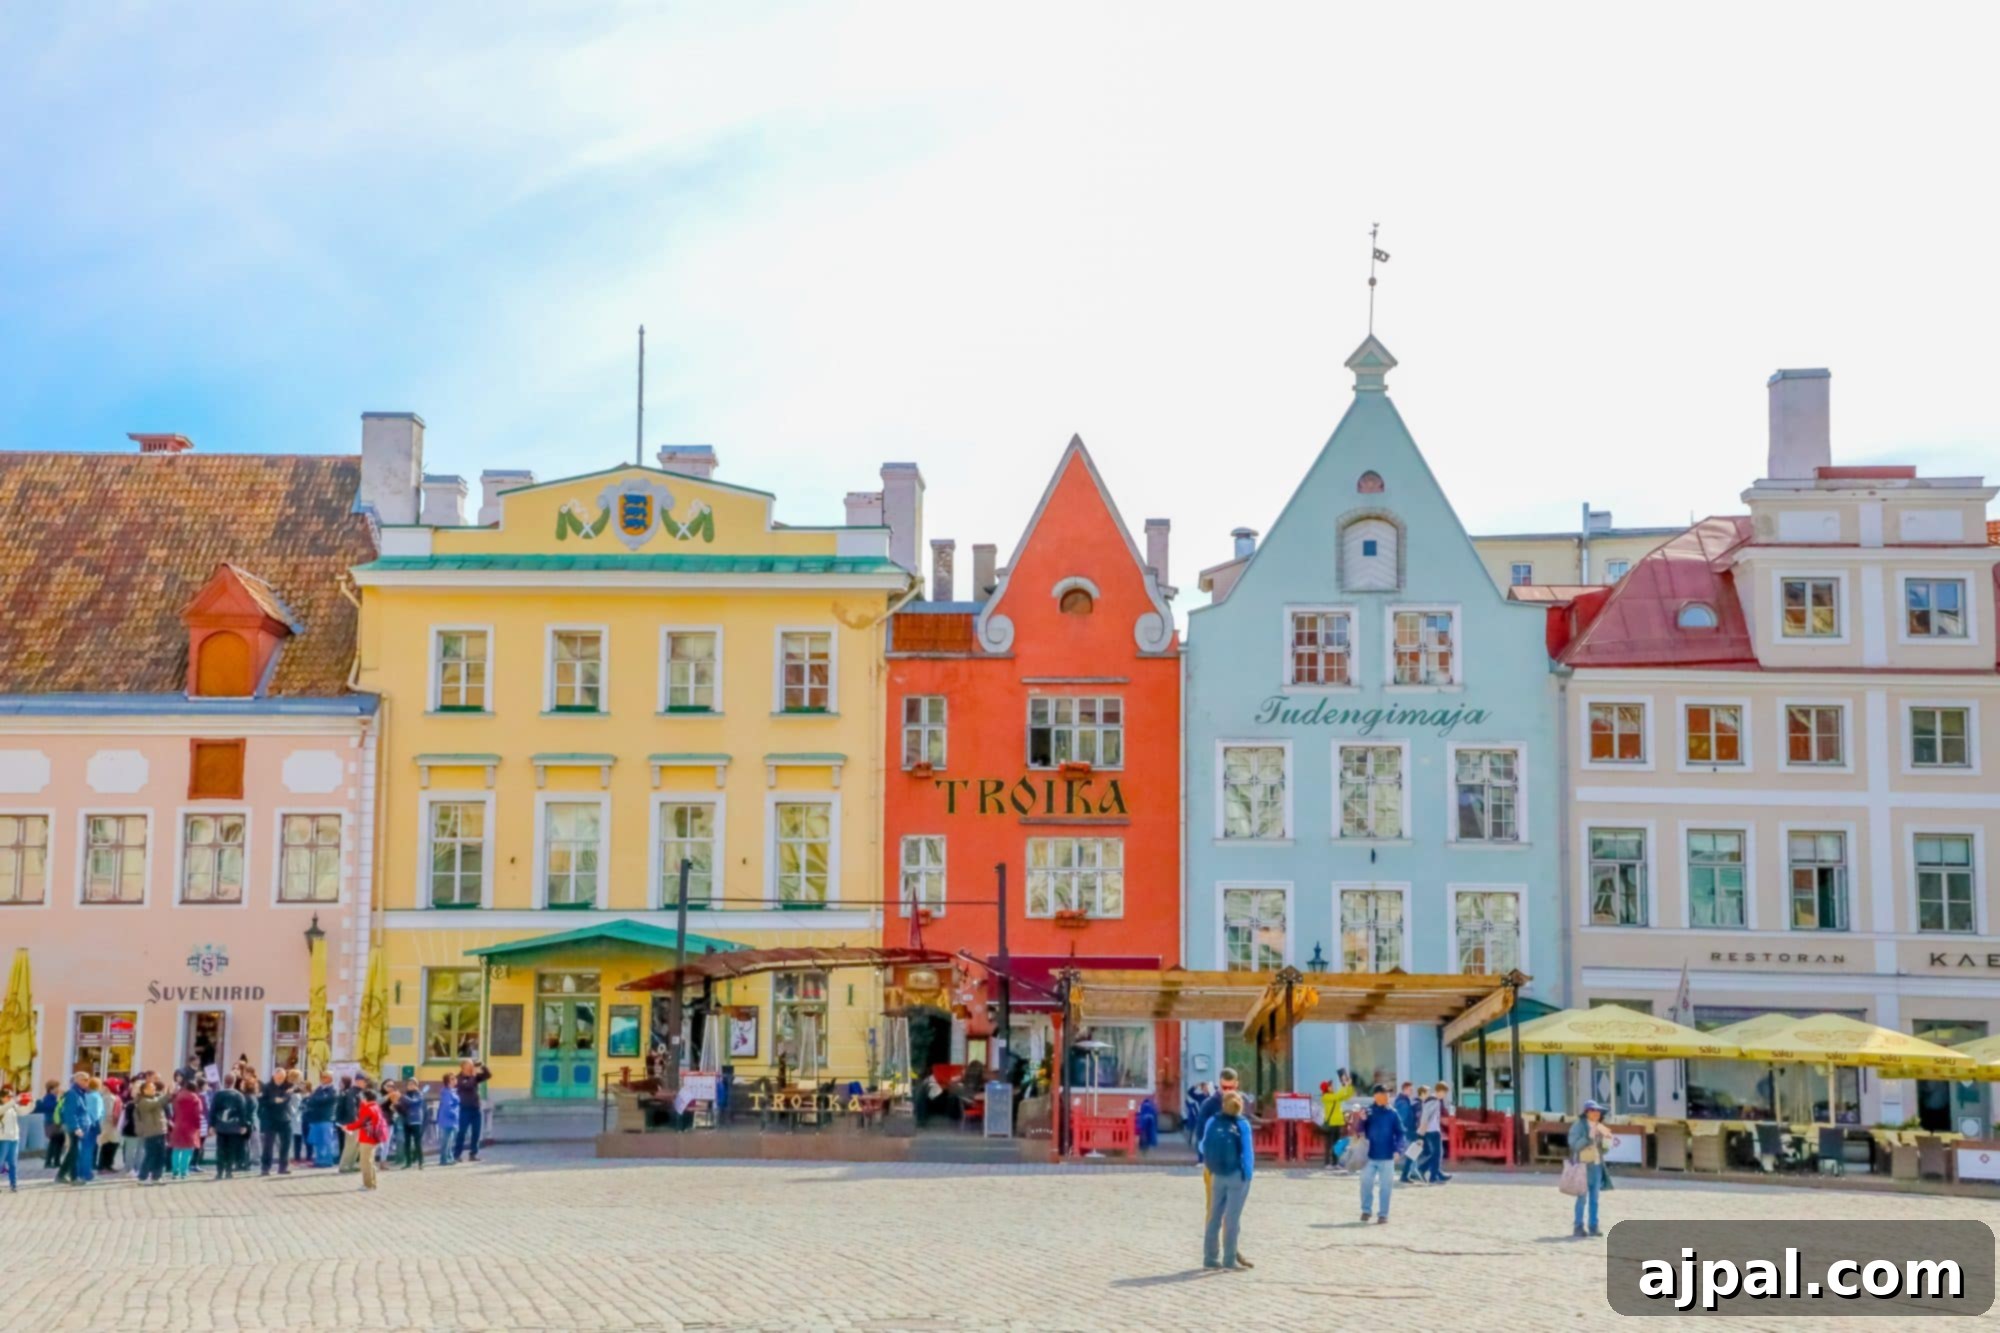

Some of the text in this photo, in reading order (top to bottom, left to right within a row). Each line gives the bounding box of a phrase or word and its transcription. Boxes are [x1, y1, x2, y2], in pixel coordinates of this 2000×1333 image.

[1254, 696, 1492, 739] Tudengimaja
[935, 775, 1129, 816] TROIKA
[1711, 952, 1845, 964] RESTORAN
[145, 980, 265, 1003] SUVENIIRID
[748, 1093, 862, 1112] TROIKA
